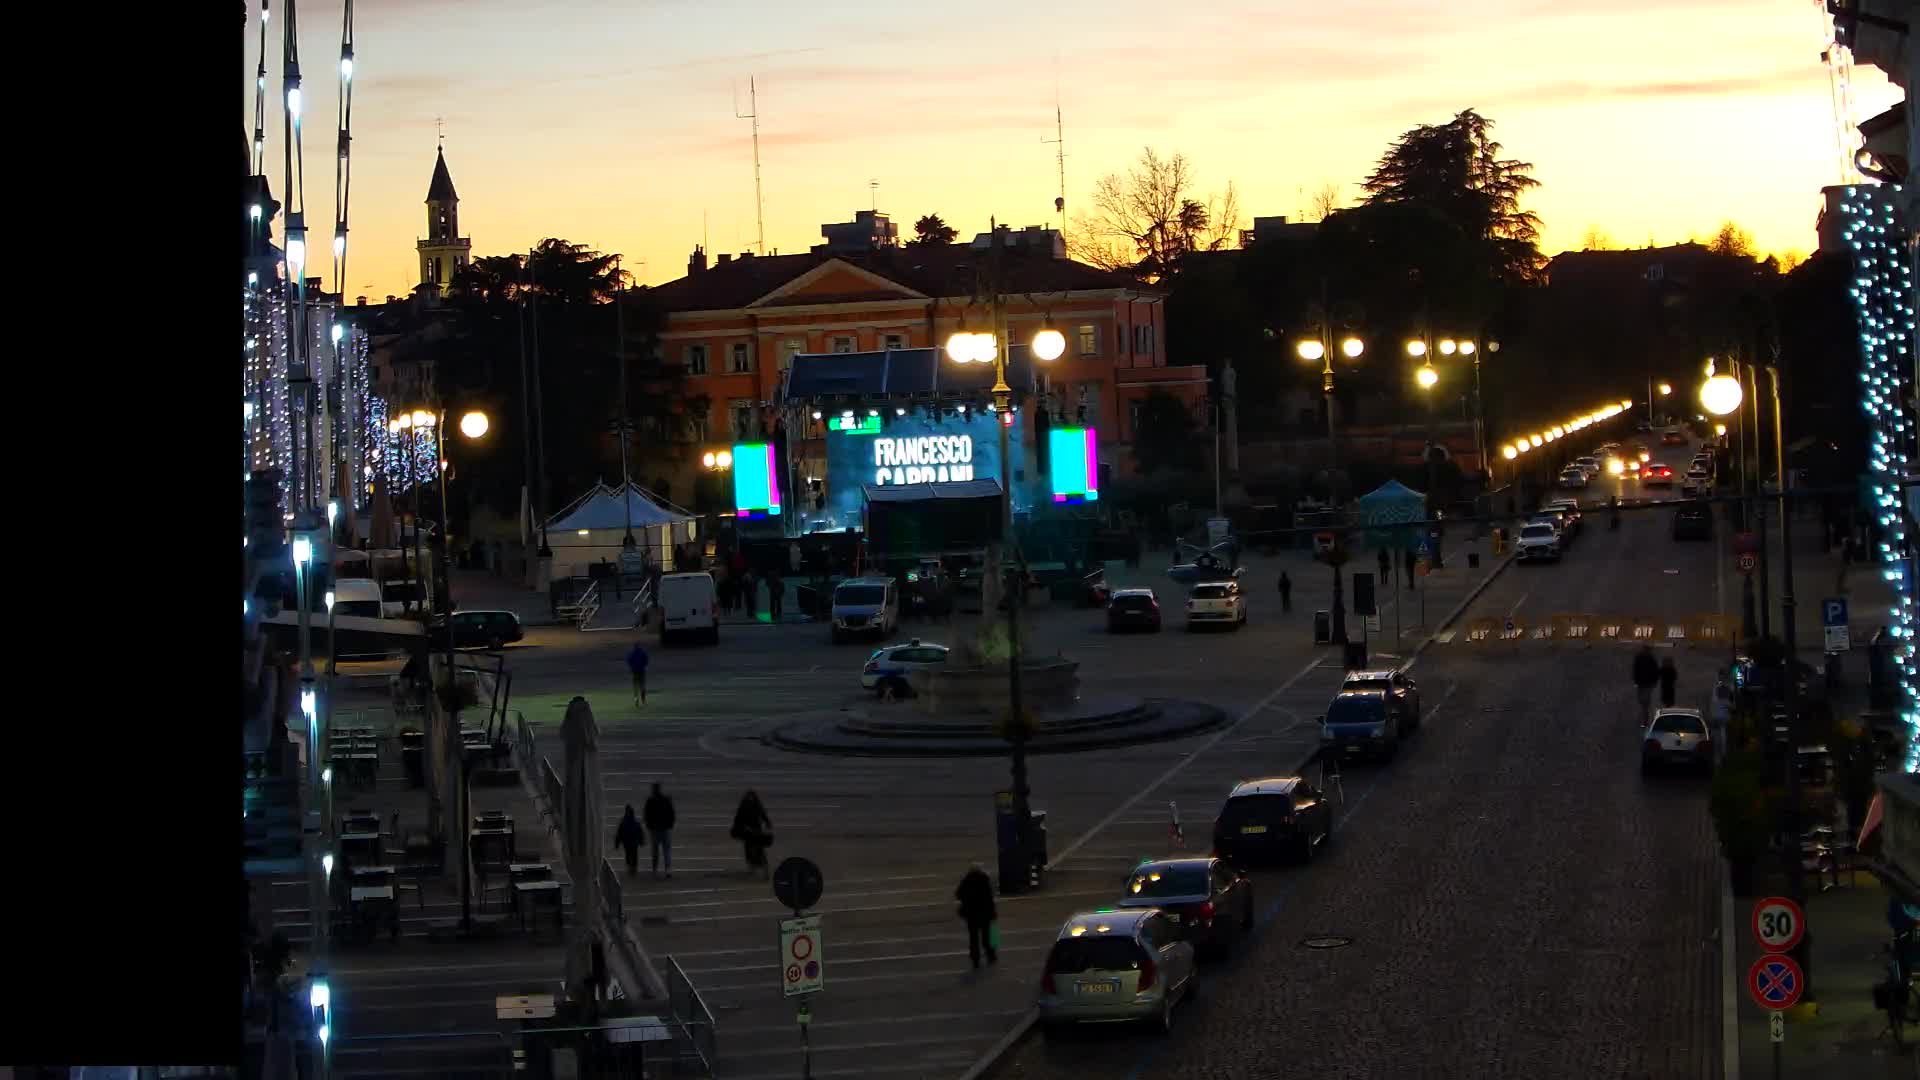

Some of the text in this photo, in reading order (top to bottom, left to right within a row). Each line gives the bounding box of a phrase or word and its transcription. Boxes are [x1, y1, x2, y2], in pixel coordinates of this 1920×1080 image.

[874, 434, 973, 467] FRANCESCO
[1827, 602, 1842, 622] P
[1762, 911, 1791, 938] 30
